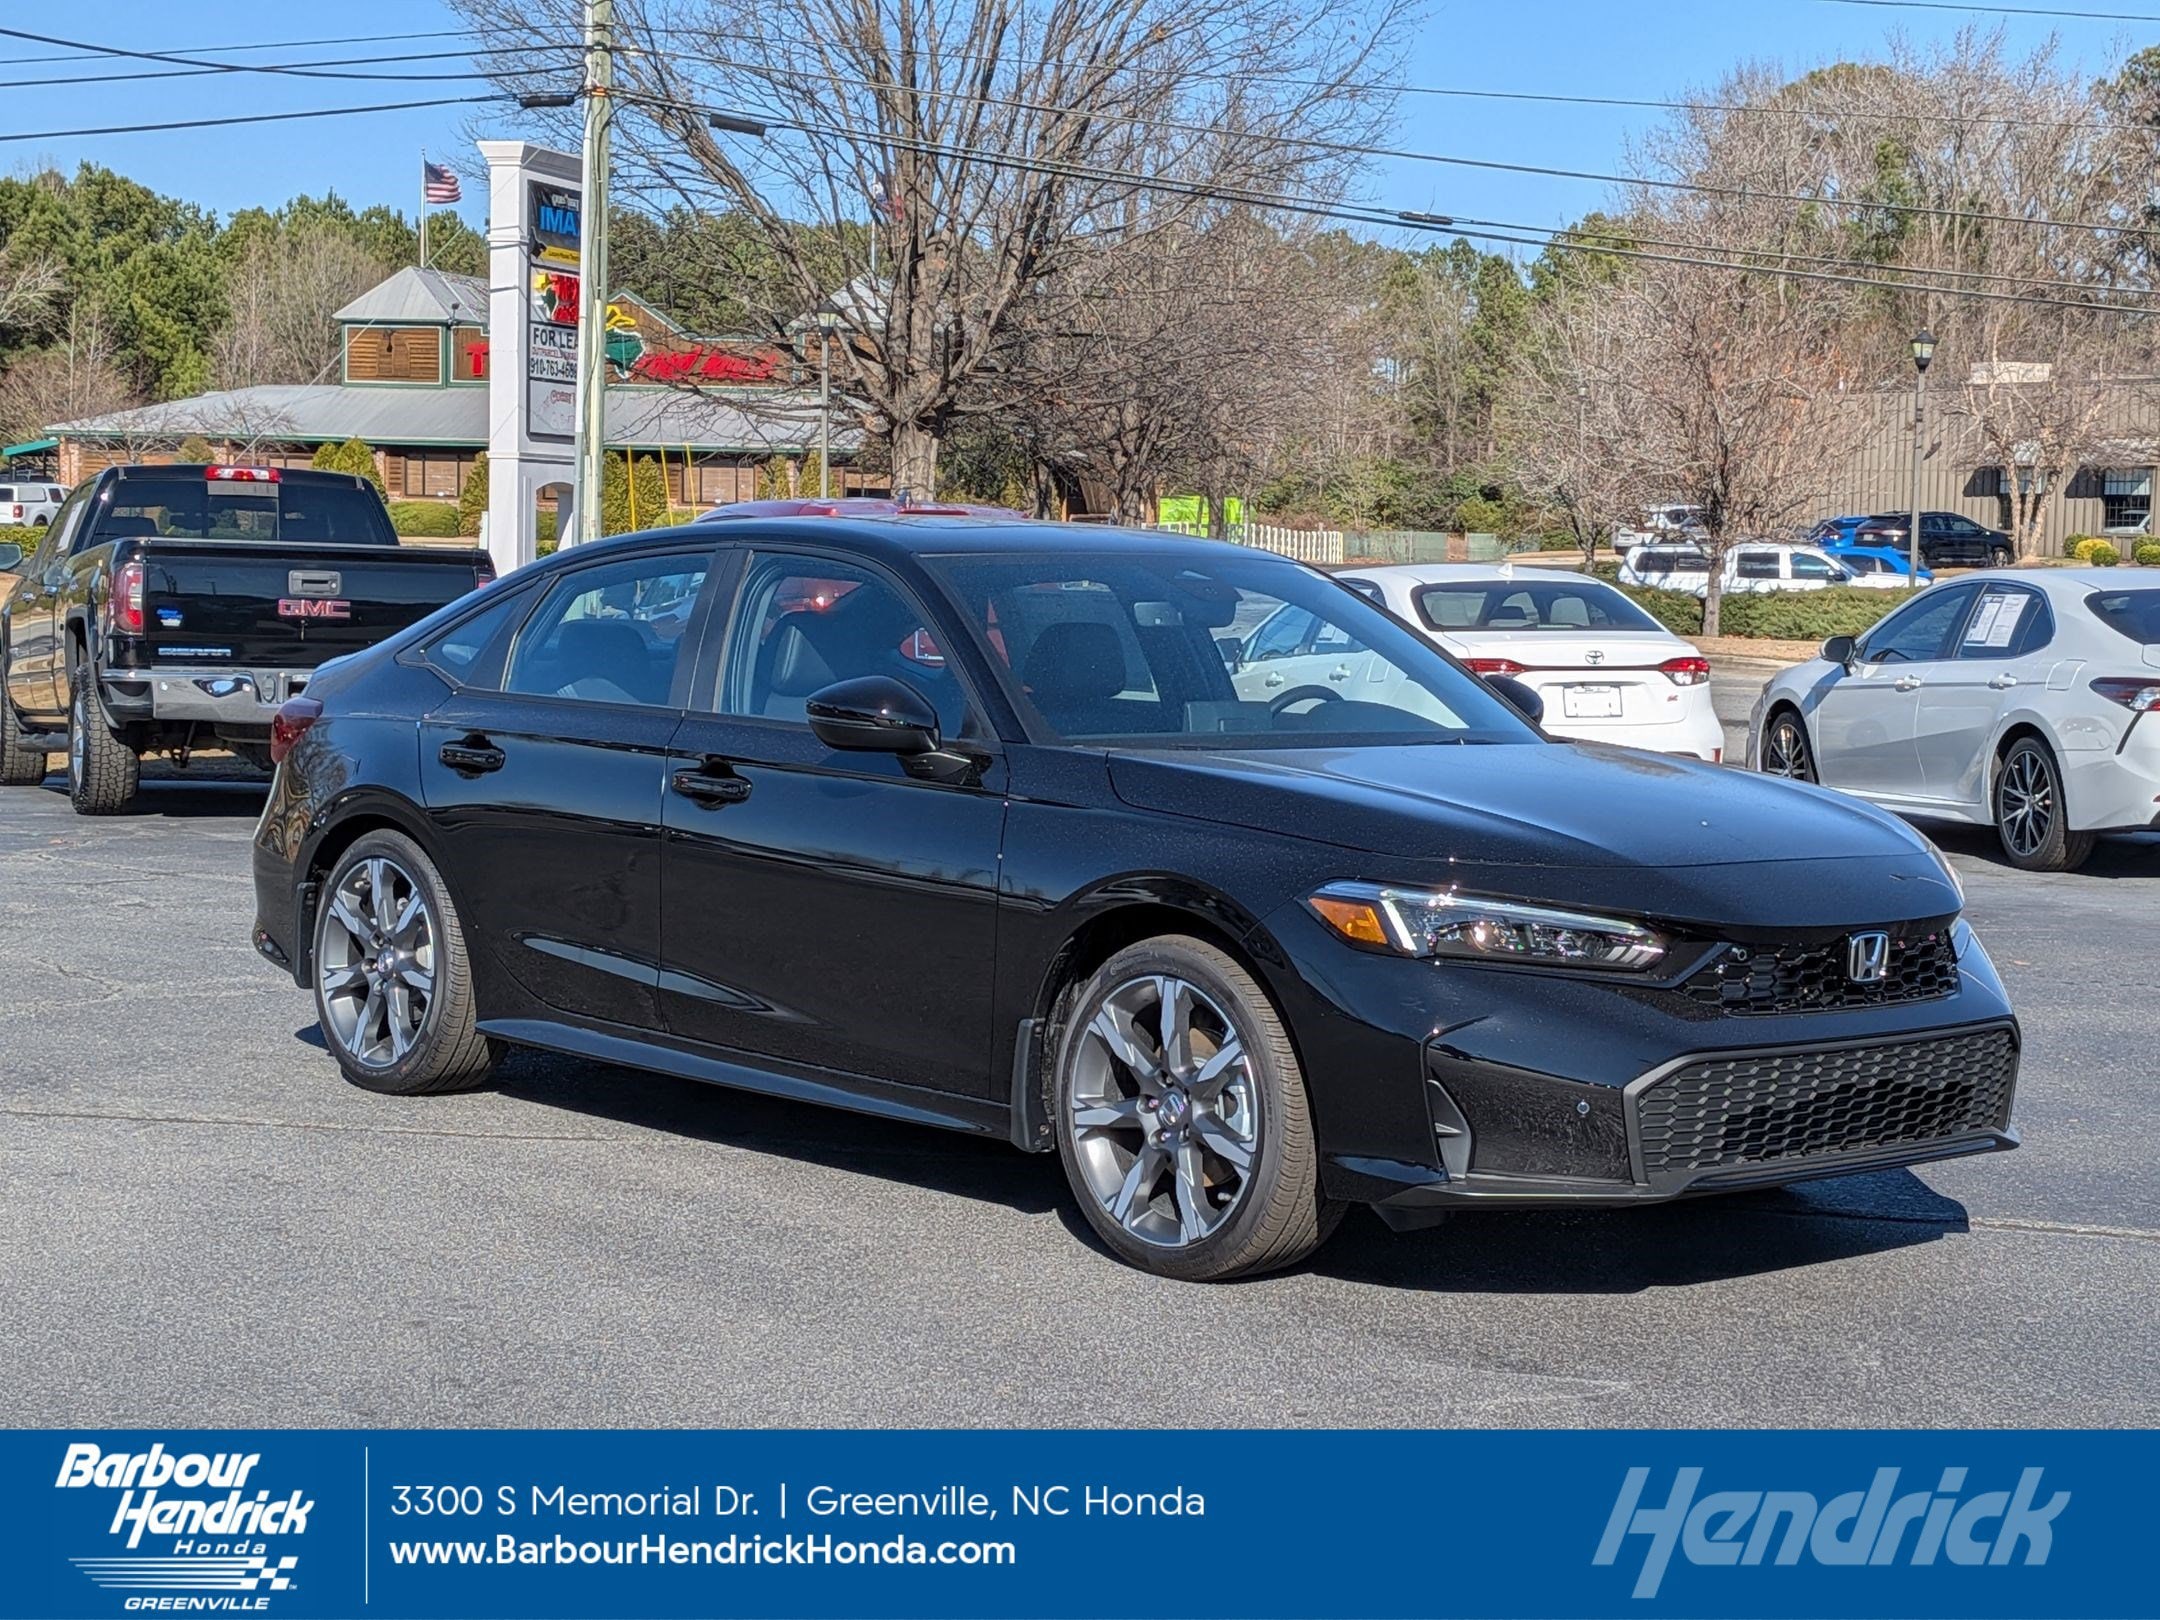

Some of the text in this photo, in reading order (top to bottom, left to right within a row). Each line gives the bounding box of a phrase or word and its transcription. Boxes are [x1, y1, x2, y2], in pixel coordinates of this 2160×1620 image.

[541, 205, 580, 236] IMA
[533, 327, 556, 347] FOR
[278, 599, 351, 618] GMC
